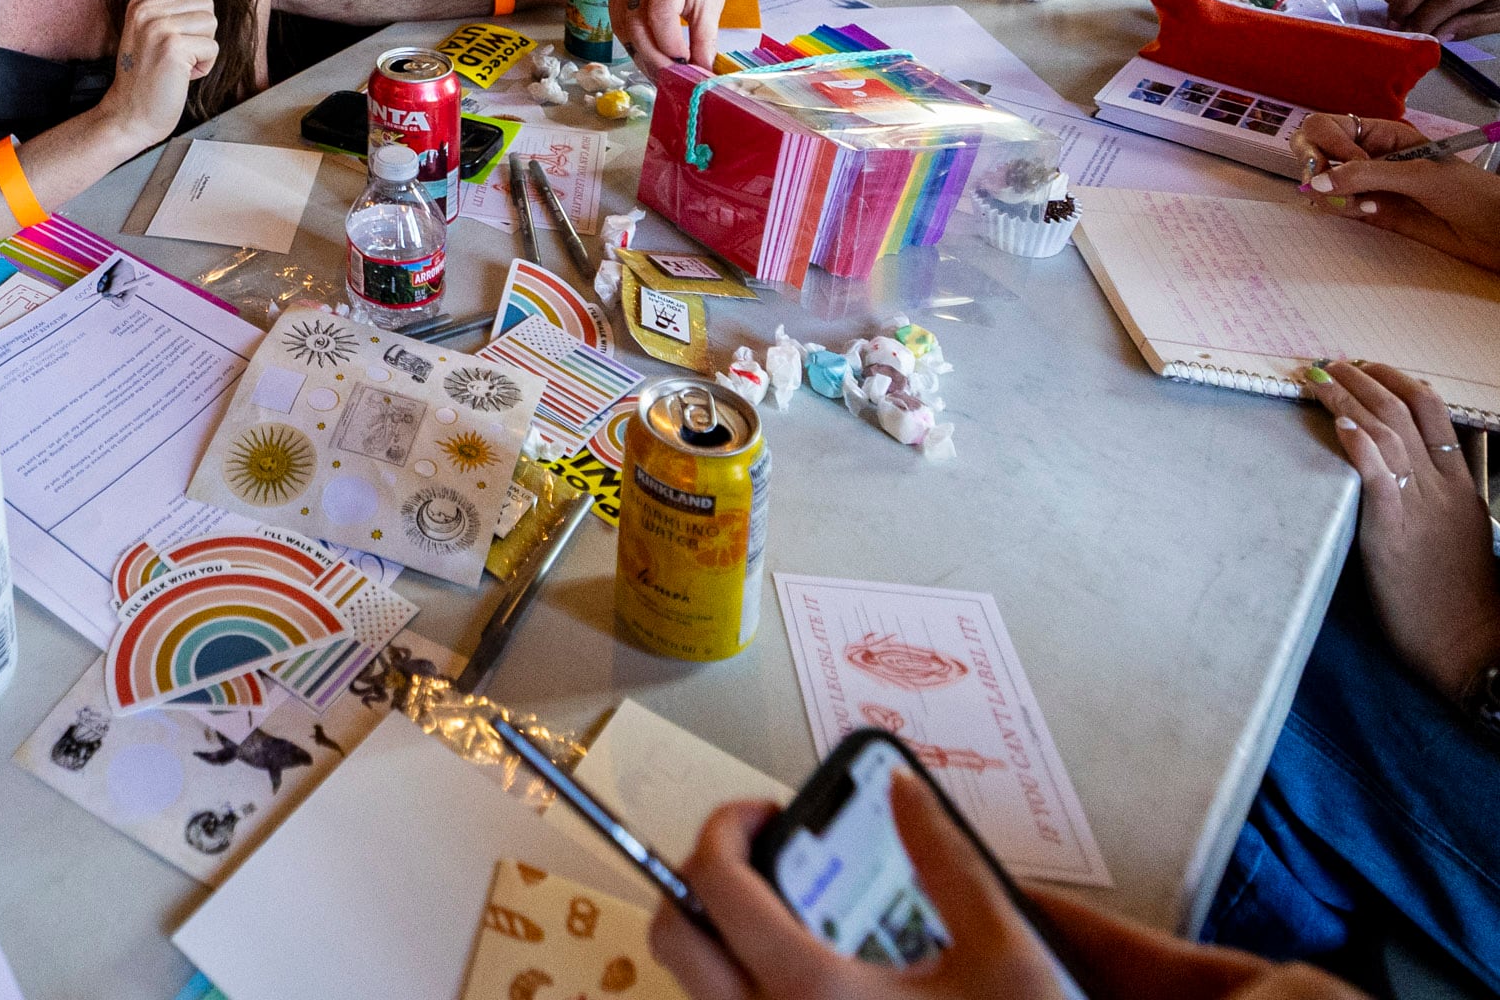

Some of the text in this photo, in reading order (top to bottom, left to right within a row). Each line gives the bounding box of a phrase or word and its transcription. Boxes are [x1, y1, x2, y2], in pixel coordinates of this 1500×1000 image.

[440, 26, 487, 58] UTA
[457, 32, 512, 67] WILD
[476, 36, 530, 81] Protect
[368, 100, 431, 131] INTA
[415, 256, 445, 284] ARROW
[635, 468, 714, 510] KIRKLAND
[264, 530, 333, 566] I'LL WALK WIT
[125, 565, 224, 618] I'LL WALK WITH YOU
[803, 594, 819, 612] IT
[810, 615, 845, 703] LEGISLATE
[958, 615, 1061, 846] IF YOU CAN'T LABEL IT?
